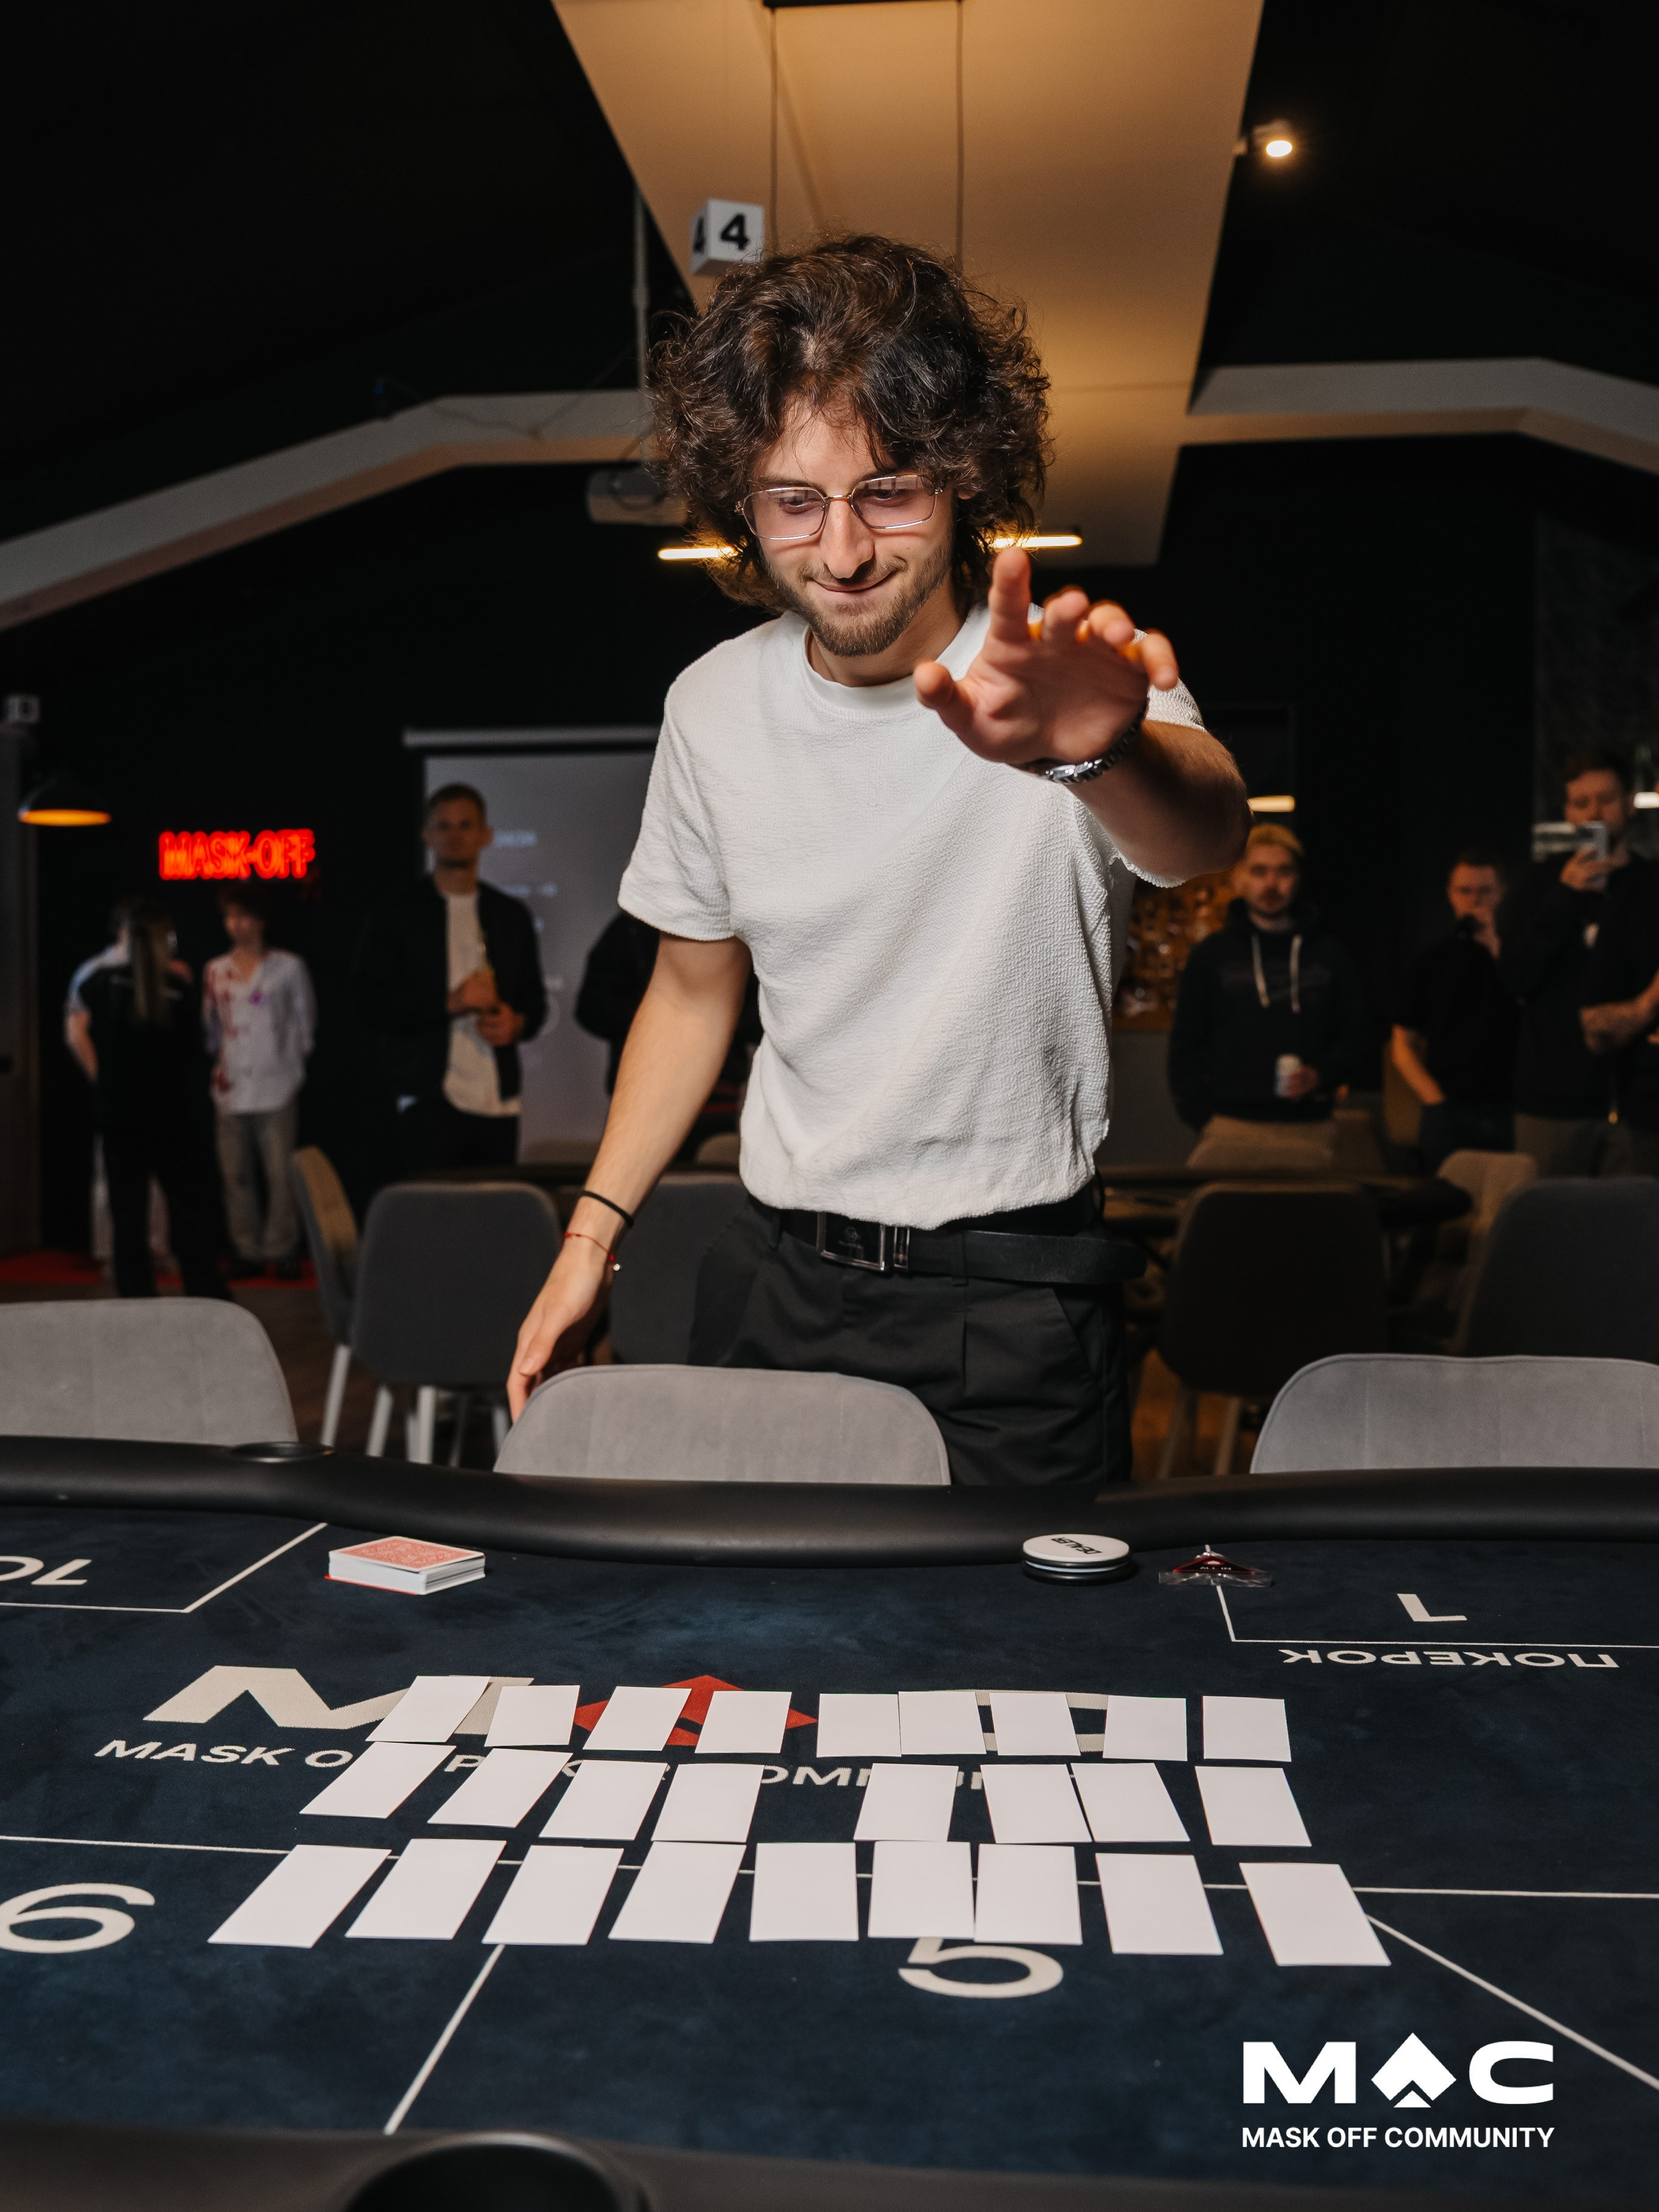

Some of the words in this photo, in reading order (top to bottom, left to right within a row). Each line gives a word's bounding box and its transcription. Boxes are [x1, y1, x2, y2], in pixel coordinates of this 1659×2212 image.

[720, 213, 750, 251] 4
[1278, 1649, 1620, 1668] ПОКЕРОК
[95, 1739, 296, 1766] MASK
[0, 1883, 156, 1954] 6
[898, 1937, 1064, 1999] 5
